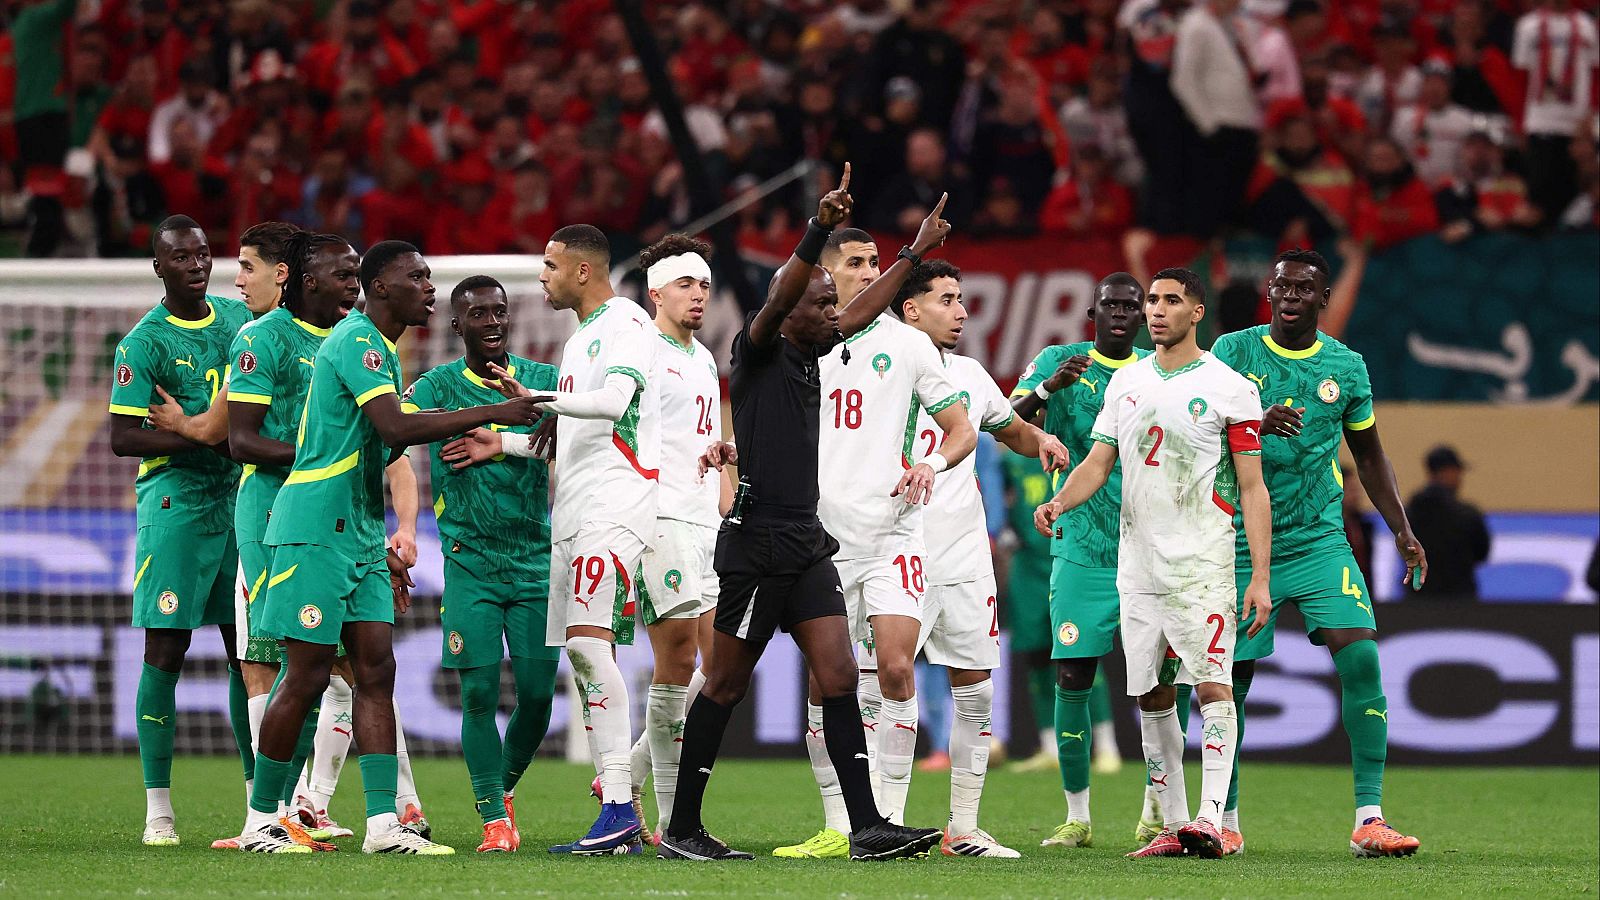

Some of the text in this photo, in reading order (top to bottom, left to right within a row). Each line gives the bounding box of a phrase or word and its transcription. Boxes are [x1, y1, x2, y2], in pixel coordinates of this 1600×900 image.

[205, 364, 231, 407] 2
[696, 394, 713, 436] 24
[829, 388, 863, 430] 18
[920, 428, 949, 458] 2
[1144, 425, 1164, 466] 2
[571, 555, 605, 595] 19
[893, 554, 924, 593] 18
[1341, 566, 1363, 600] 4
[987, 595, 999, 637] 2
[1206, 613, 1226, 654] 2
